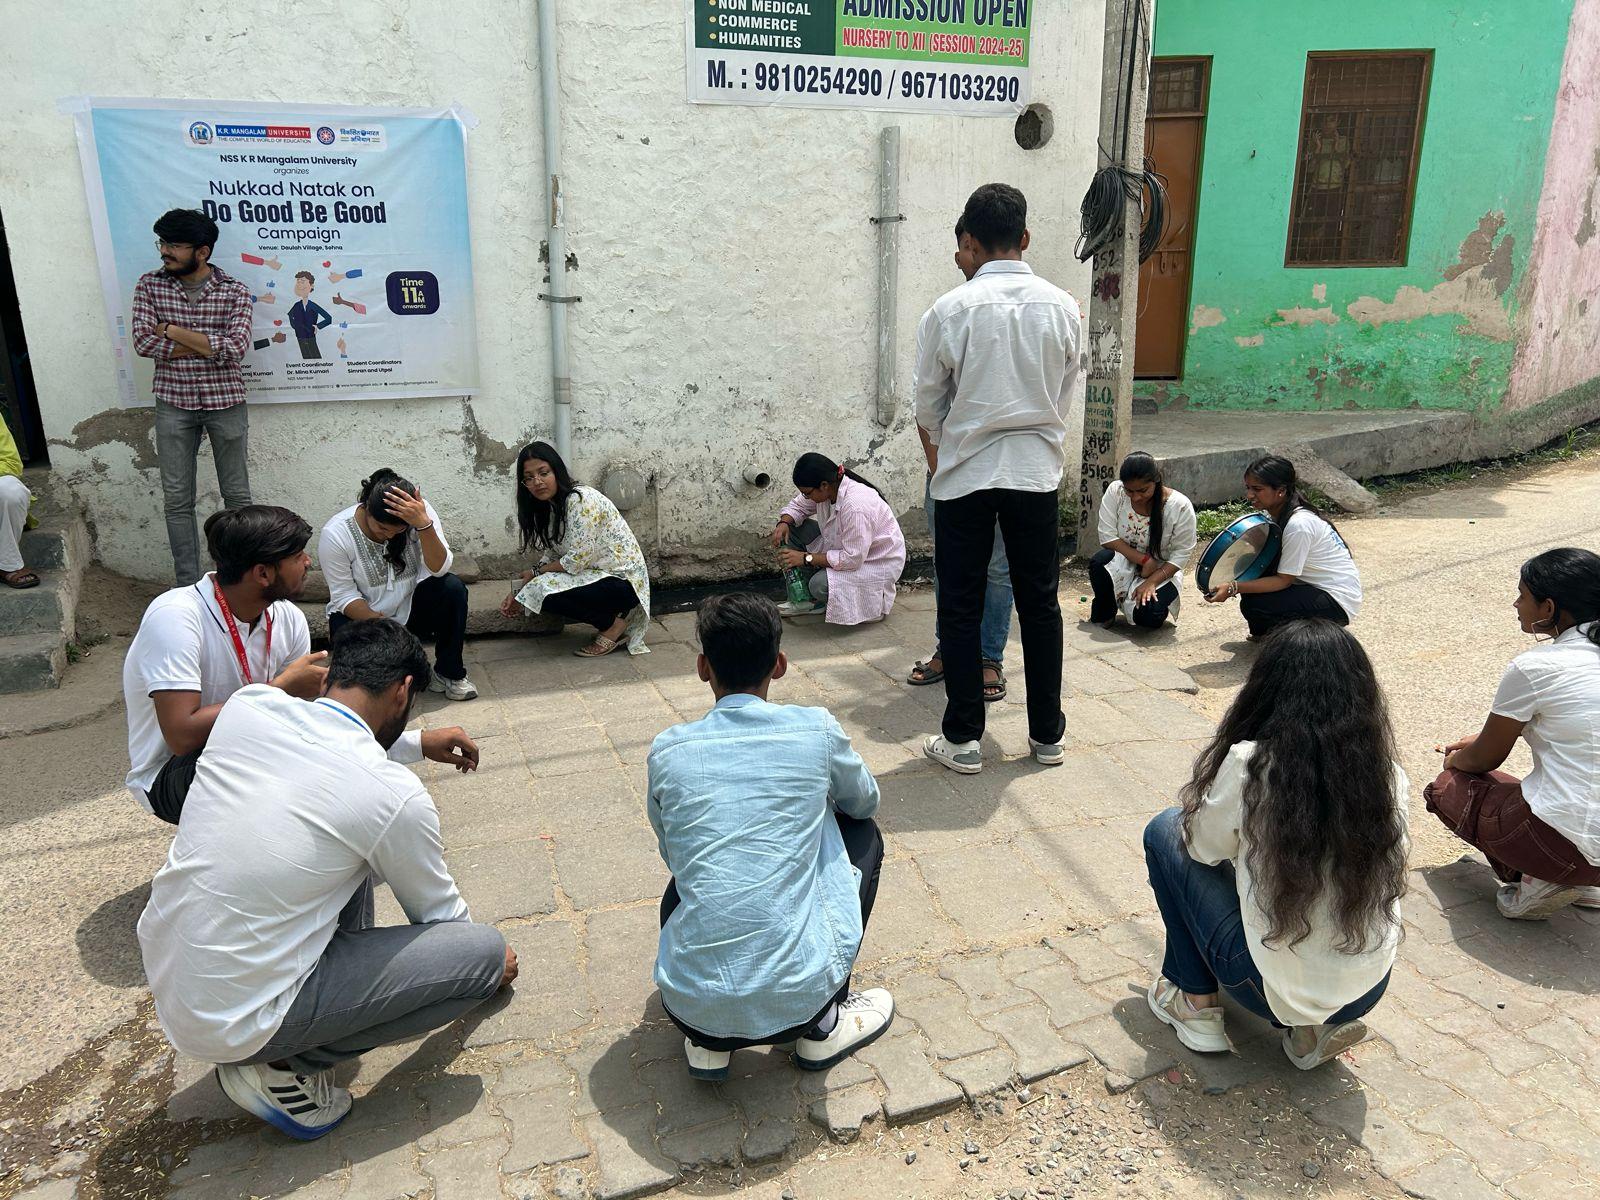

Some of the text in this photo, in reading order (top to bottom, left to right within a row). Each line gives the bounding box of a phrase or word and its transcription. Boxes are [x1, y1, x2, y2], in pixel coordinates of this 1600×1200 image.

[719, 0, 811, 15] NON MEDICAL
[843, 0, 1027, 28] ADMISSION OPEN
[719, 15, 797, 31] COMMERCE
[719, 32, 801, 48] HUMANITIES
[843, 28, 1025, 60] NURSERY TO XII (SESSION 2024-25)
[708, 60, 733, 89] M.
[755, 62, 882, 96] 9810254290
[901, 71, 1019, 103] 9671033290
[220, 155, 239, 163] NSS
[257, 156, 309, 166] Mangalam
[310, 156, 357, 167] University
[274, 168, 309, 176] organizes
[209, 180, 375, 197] Nukkad Natak on
[202, 200, 387, 224] Do Good Be Good
[257, 227, 341, 243] Campaign
[400, 278, 424, 286] Time
[402, 287, 417, 303] 11
